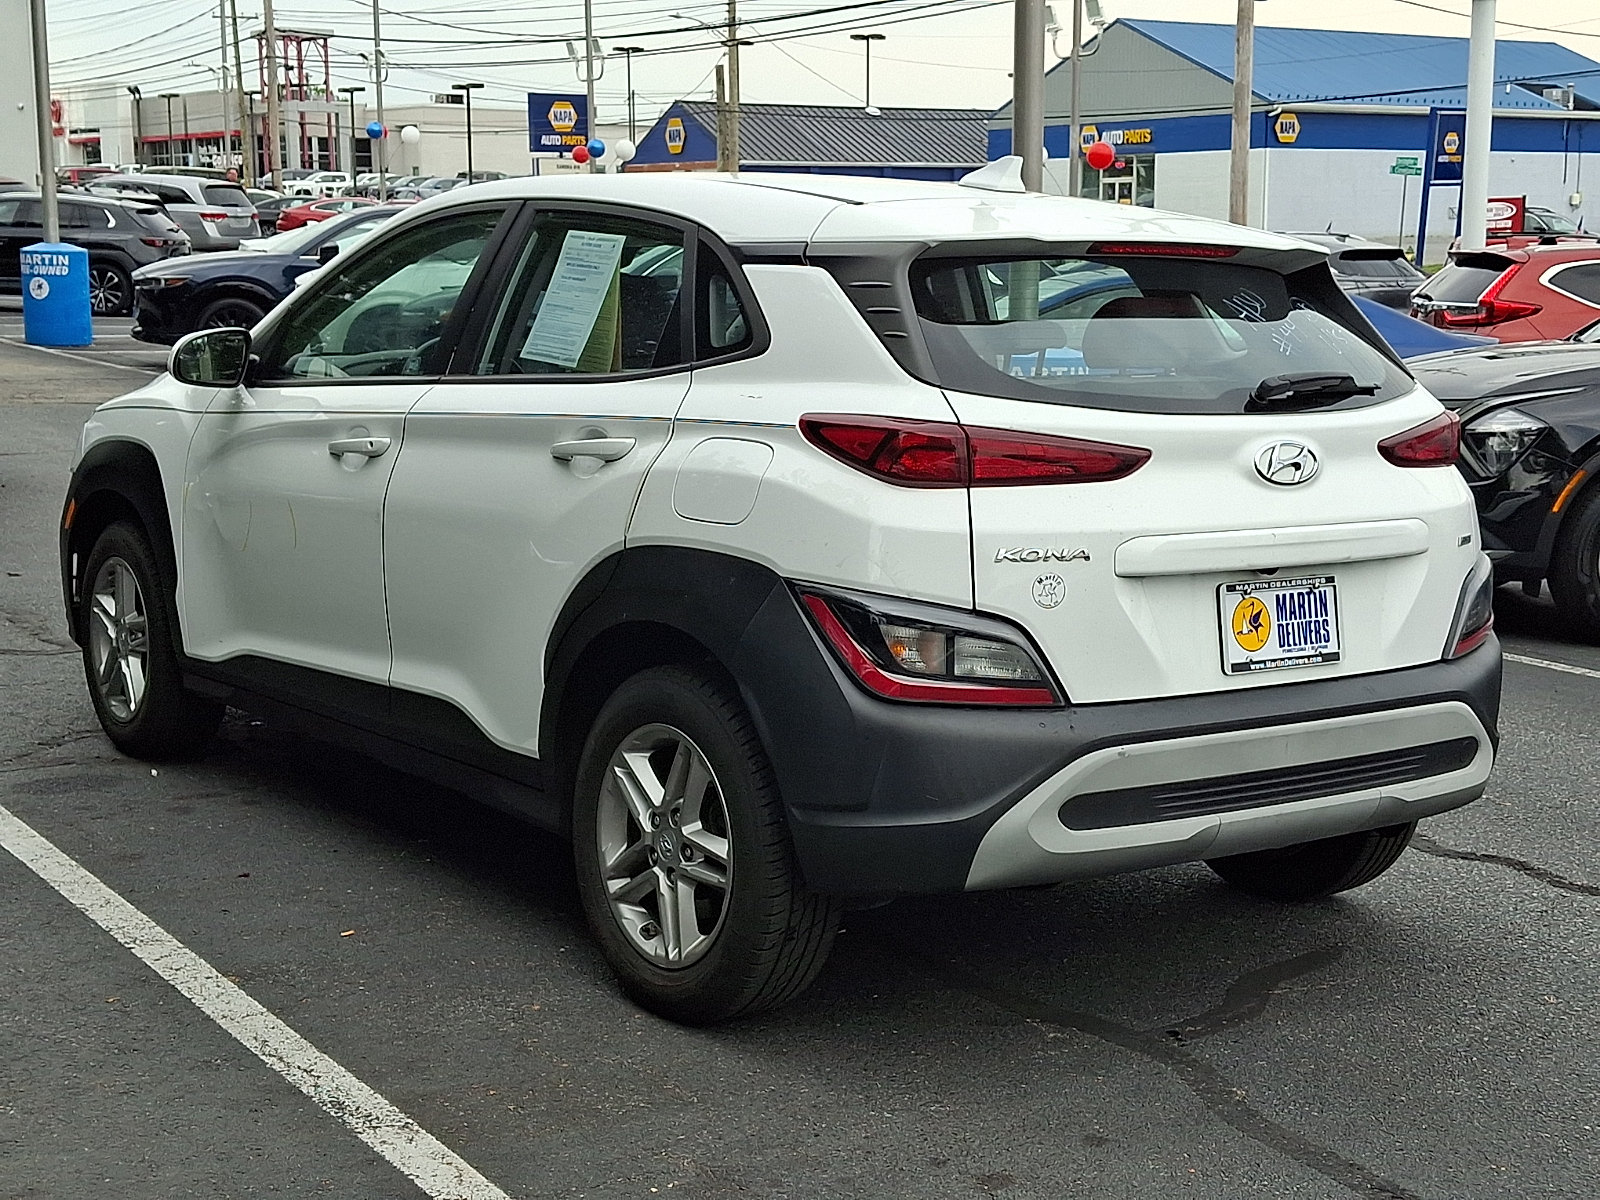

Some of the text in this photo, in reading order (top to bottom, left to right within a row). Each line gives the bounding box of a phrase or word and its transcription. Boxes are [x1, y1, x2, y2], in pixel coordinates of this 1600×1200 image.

[553, 110, 573, 123] NAPA
[1280, 121, 1296, 134] NAPA
[541, 135, 586, 146] AUTO PARTS
[668, 128, 682, 143] NAPA
[1101, 130, 1123, 144] AUTO
[1124, 129, 1151, 144] PARTS
[994, 548, 1091, 563] KONA
[1037, 575, 1061, 585] Martin
[1236, 577, 1326, 591] MARTIN DEALERSHIPS
[1275, 590, 1329, 622] MARTIN
[1277, 619, 1330, 648] DELIVERS
[1250, 656, 1323, 670] www.MartinDelivers.com
